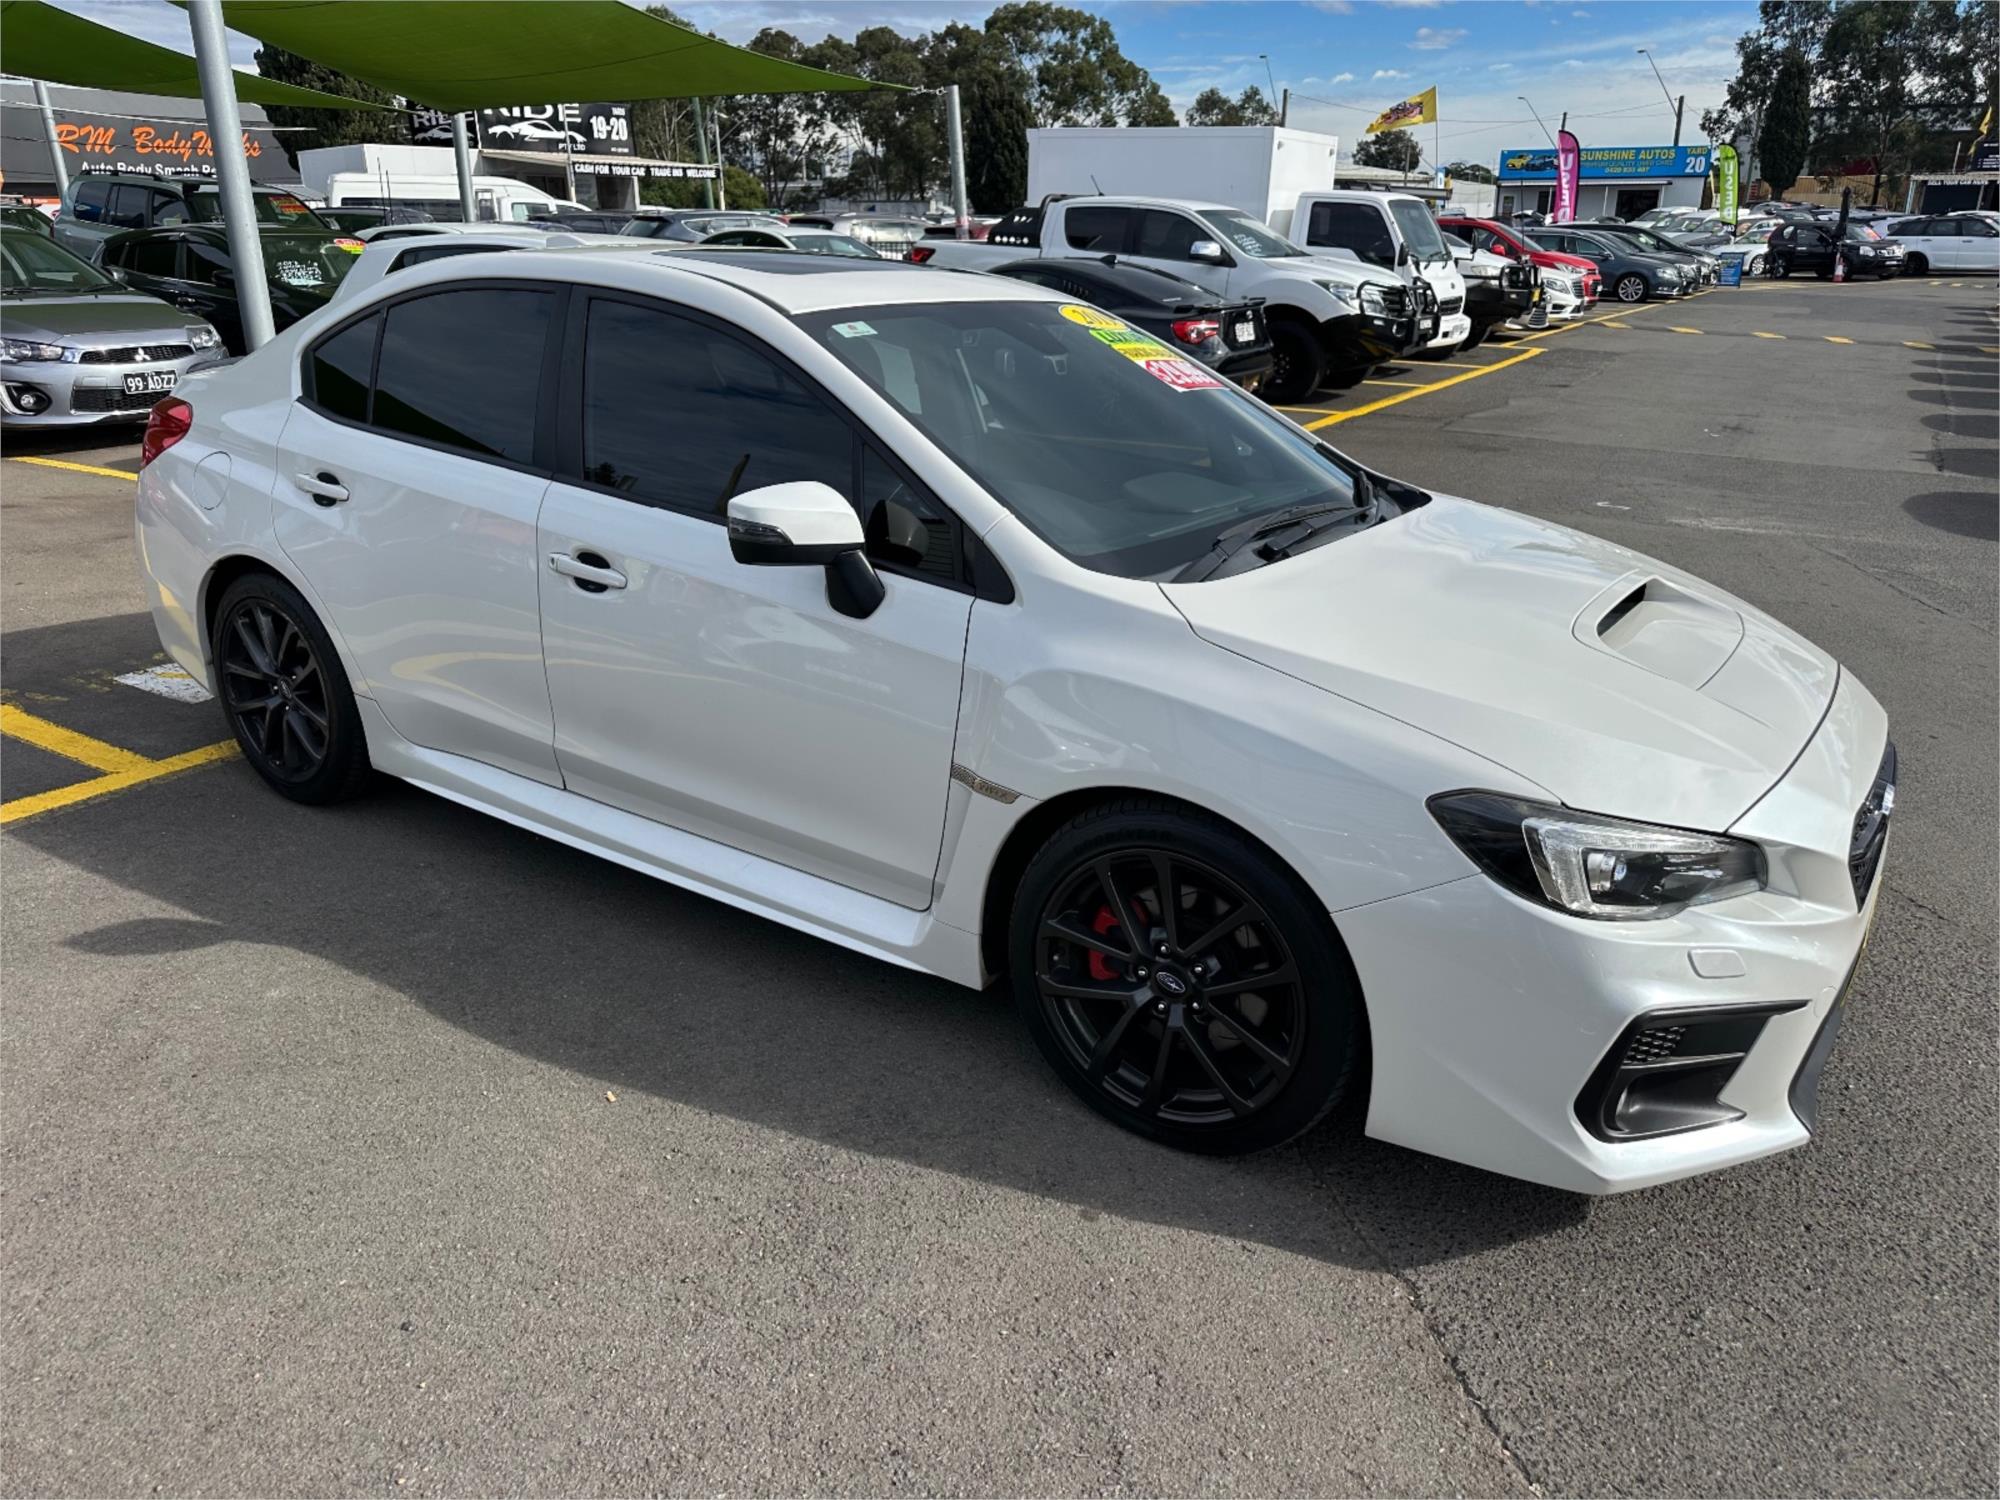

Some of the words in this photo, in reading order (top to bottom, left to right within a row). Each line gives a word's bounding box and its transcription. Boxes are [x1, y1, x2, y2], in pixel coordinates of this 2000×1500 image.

[590, 115, 628, 141] 19-20
[55, 122, 120, 156] RM
[1580, 149, 1636, 160] SUNSHINE
[1638, 148, 1676, 159] AUTOS
[1686, 147, 1708, 155] YARD
[574, 163, 594, 173] CASH
[595, 164, 609, 174] FOR
[611, 166, 630, 176] YOUR
[631, 166, 646, 176] CAR
[650, 167, 672, 177] TRADE
[686, 168, 716, 178] WELCOME
[1684, 156, 1706, 173] 20
